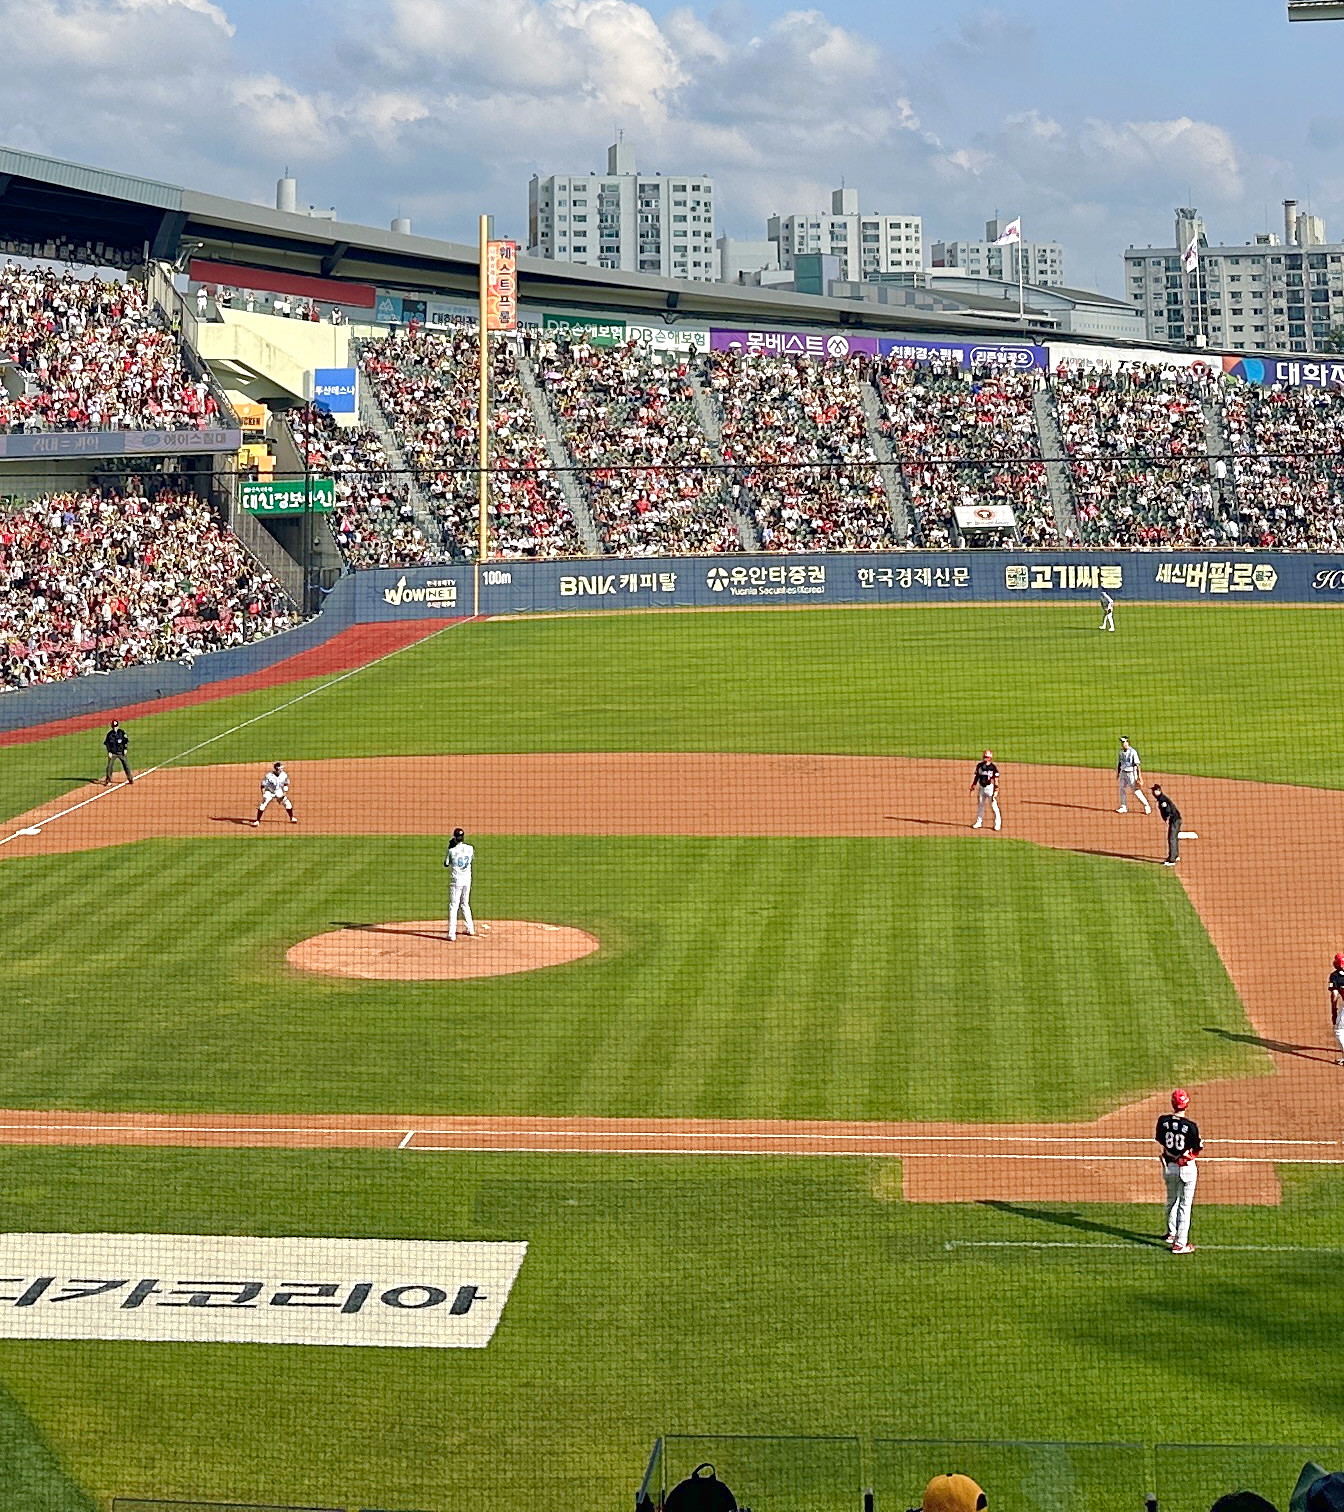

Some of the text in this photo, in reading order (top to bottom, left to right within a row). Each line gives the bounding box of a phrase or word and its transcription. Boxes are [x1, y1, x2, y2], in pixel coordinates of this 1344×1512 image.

[630, 328, 706, 346] DB 손해보험
[746, 332, 825, 356] 몽베스트
[164, 433, 227, 447] 에이스침대
[483, 571, 512, 586] 100m
[560, 572, 677, 596] BNK 캐피탈
[730, 565, 825, 585] 유안타증권
[857, 566, 970, 589] 한국경제신문
[1030, 565, 1123, 589] 고기싸롱
[1165, 1132, 1185, 1150] 80
